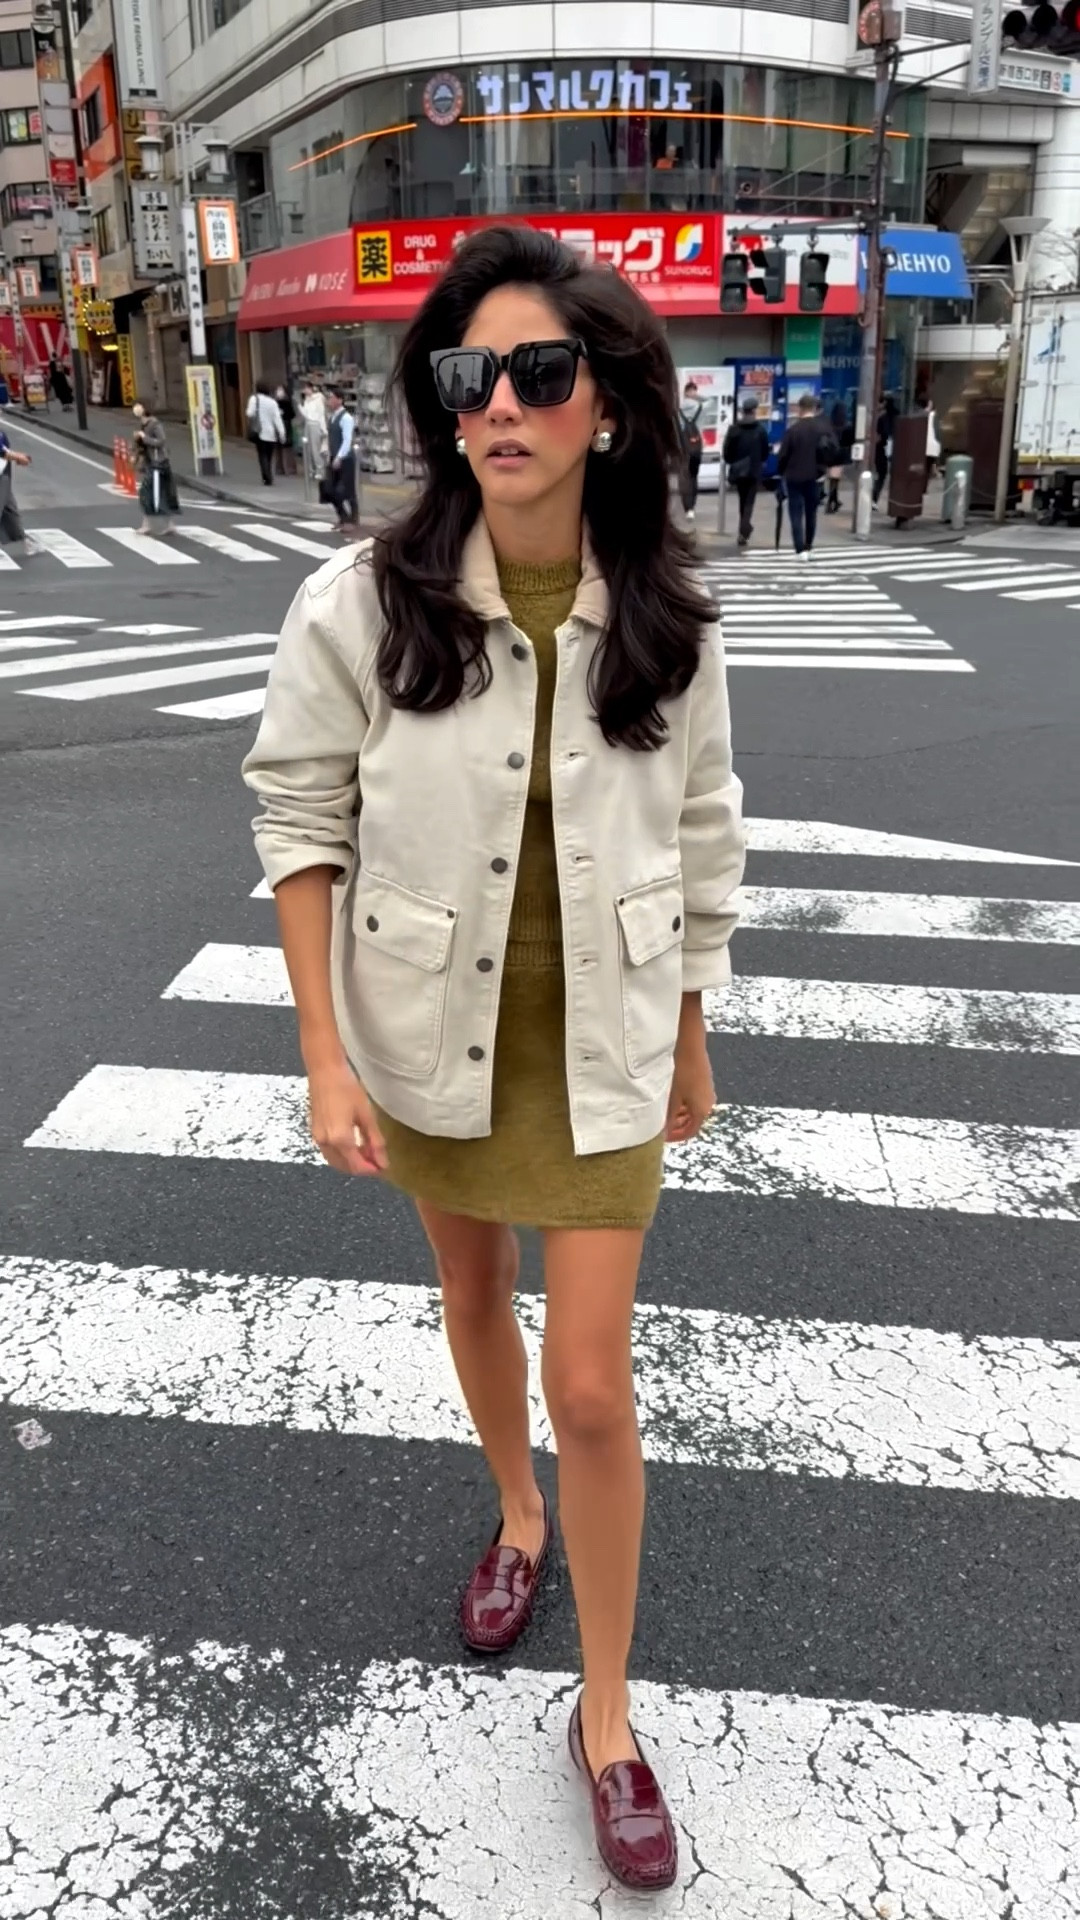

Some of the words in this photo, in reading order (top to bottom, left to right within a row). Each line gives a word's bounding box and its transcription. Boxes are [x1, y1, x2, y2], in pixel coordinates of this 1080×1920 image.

[477, 69, 692, 114] サンマルクカフェ
[404, 234, 437, 249] DRUG
[361, 236, 388, 278] 薬
[664, 265, 713, 276] SUNDRUG
